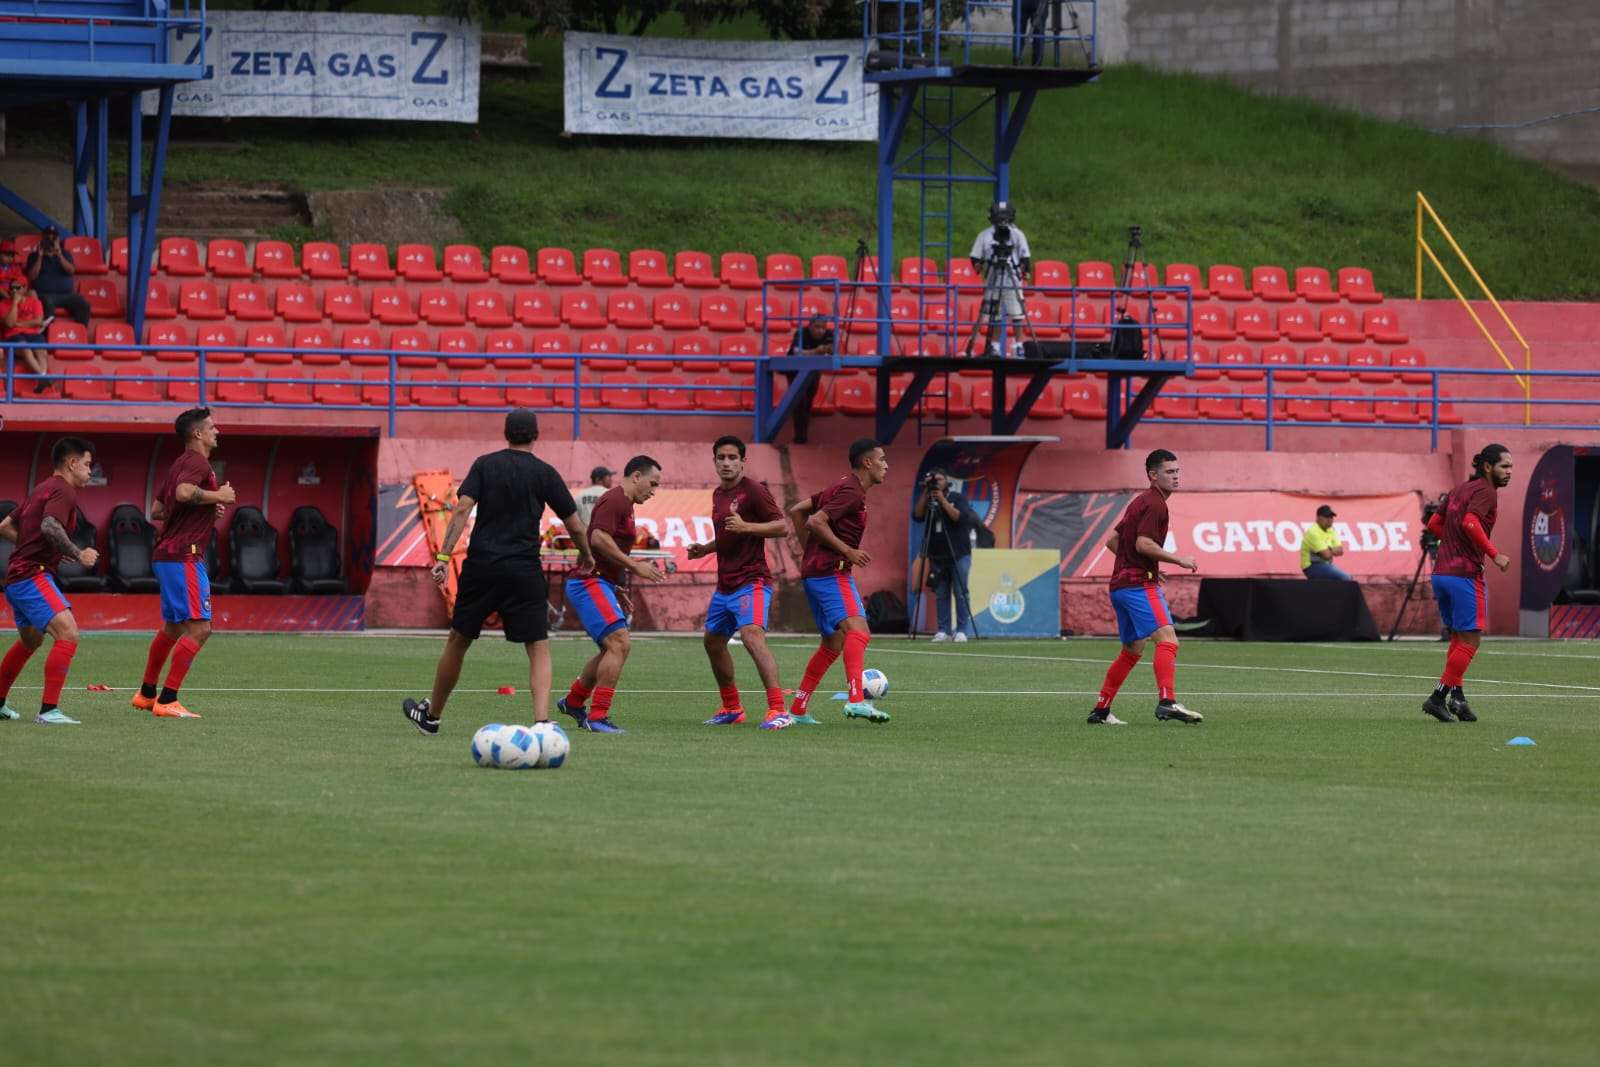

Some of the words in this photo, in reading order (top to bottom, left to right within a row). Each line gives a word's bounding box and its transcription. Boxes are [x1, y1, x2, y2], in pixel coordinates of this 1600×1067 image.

[230, 52, 316, 76] ZETA
[327, 52, 396, 78] GAS
[411, 32, 448, 84] Z
[595, 47, 632, 98] Z
[648, 71, 730, 97] ZETA
[739, 76, 803, 99] GAS
[815, 54, 849, 104] Z
[177, 92, 214, 102] GAS
[412, 97, 448, 107] GAS
[596, 111, 631, 121] GAS
[815, 117, 850, 126] GAS
[1193, 520, 1412, 553] GATOADE
